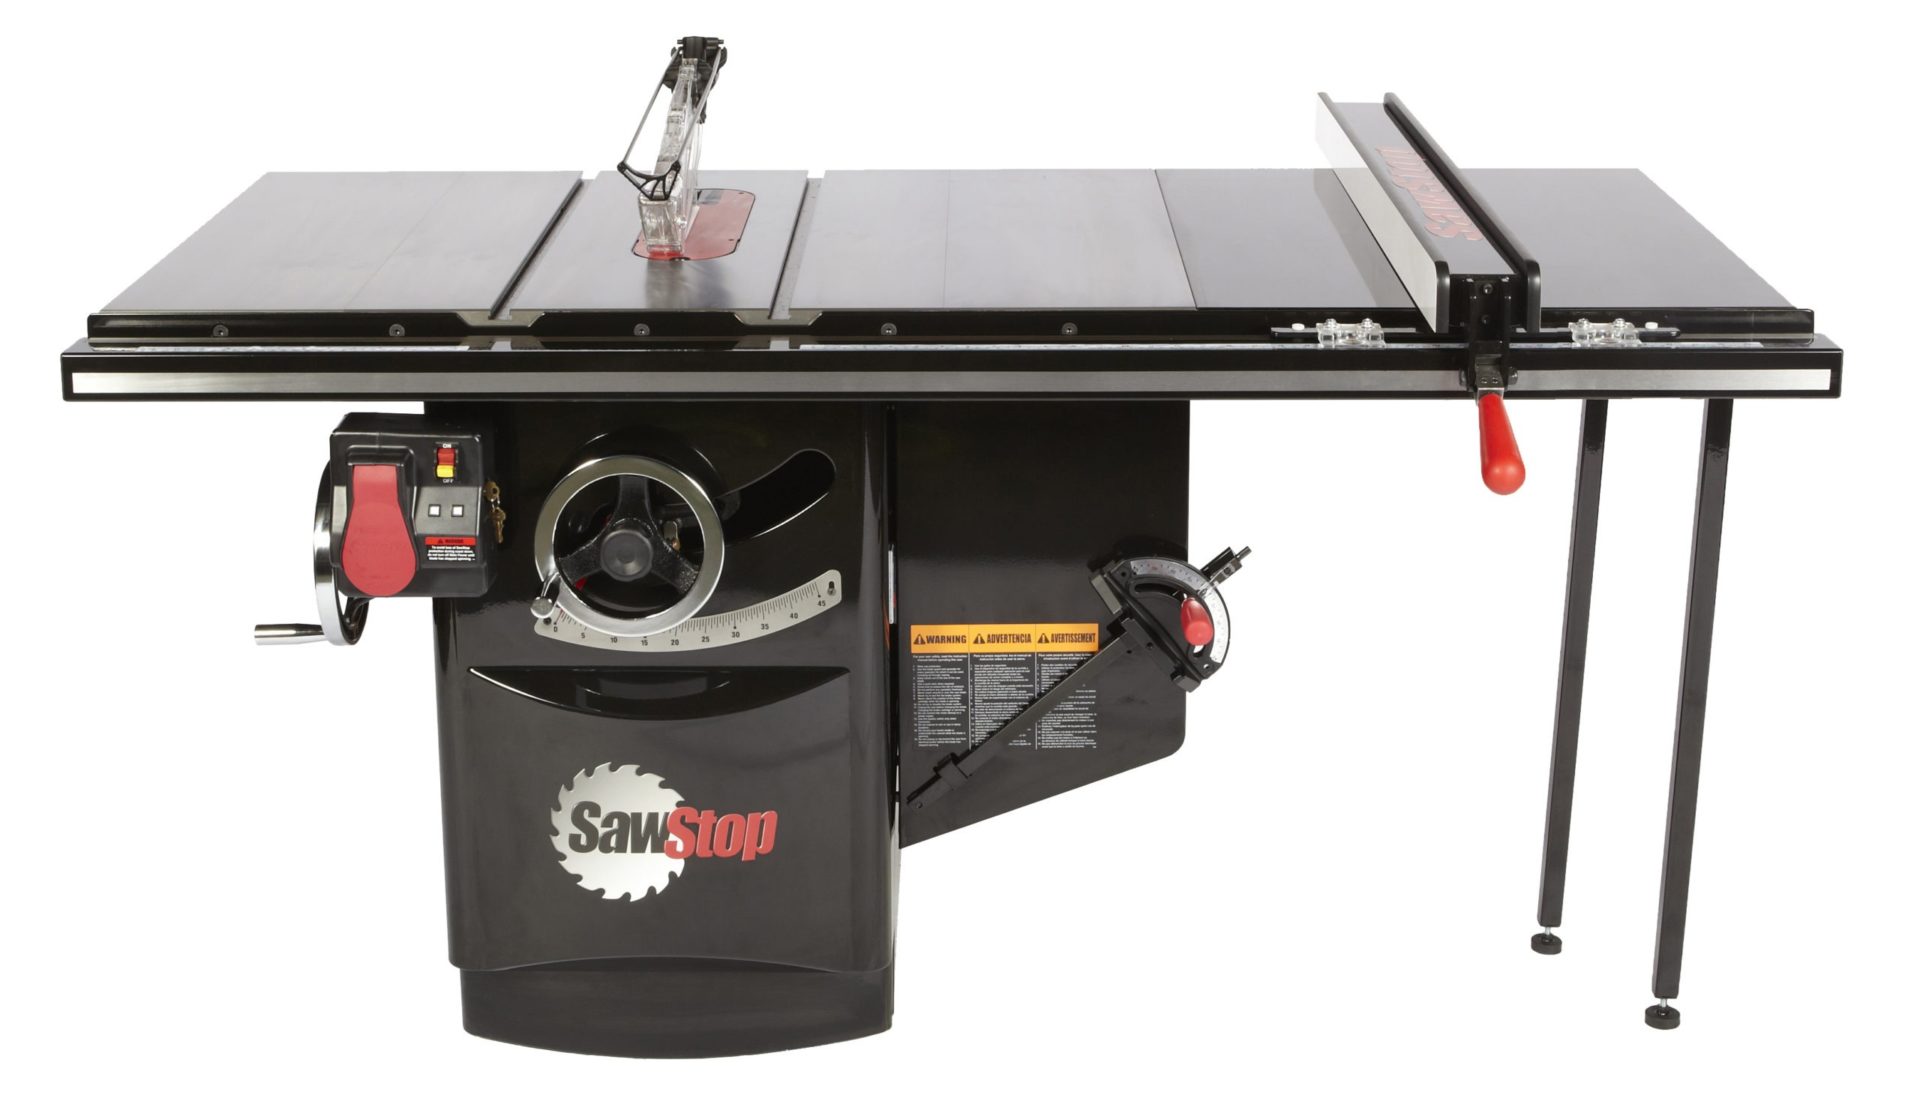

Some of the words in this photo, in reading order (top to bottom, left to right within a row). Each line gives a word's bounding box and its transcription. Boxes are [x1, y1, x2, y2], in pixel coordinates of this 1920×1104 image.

[641, 639, 649, 647] 15
[731, 631, 741, 639] 30
[926, 635, 967, 644] WARNING
[987, 633, 1032, 644] ADVERTENCIA
[1051, 633, 1096, 643] AVERTISSEMENT
[568, 801, 778, 862] SawStop
